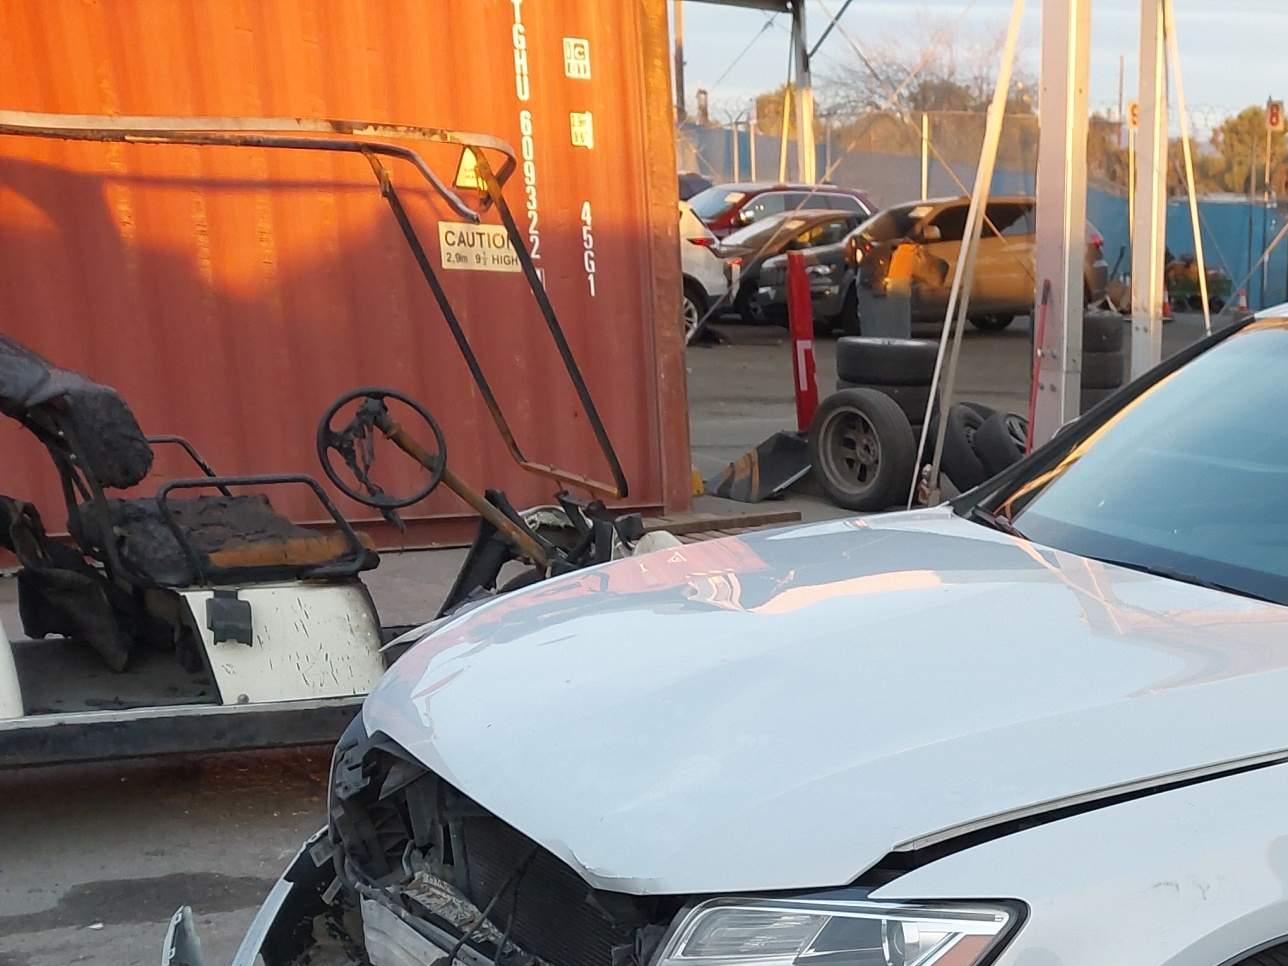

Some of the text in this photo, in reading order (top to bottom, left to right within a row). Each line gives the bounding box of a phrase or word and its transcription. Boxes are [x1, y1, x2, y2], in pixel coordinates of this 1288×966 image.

[1268, 103, 1281, 127] 8
[519, 109, 542, 259] 609322
[580, 201, 596, 297] 45G1
